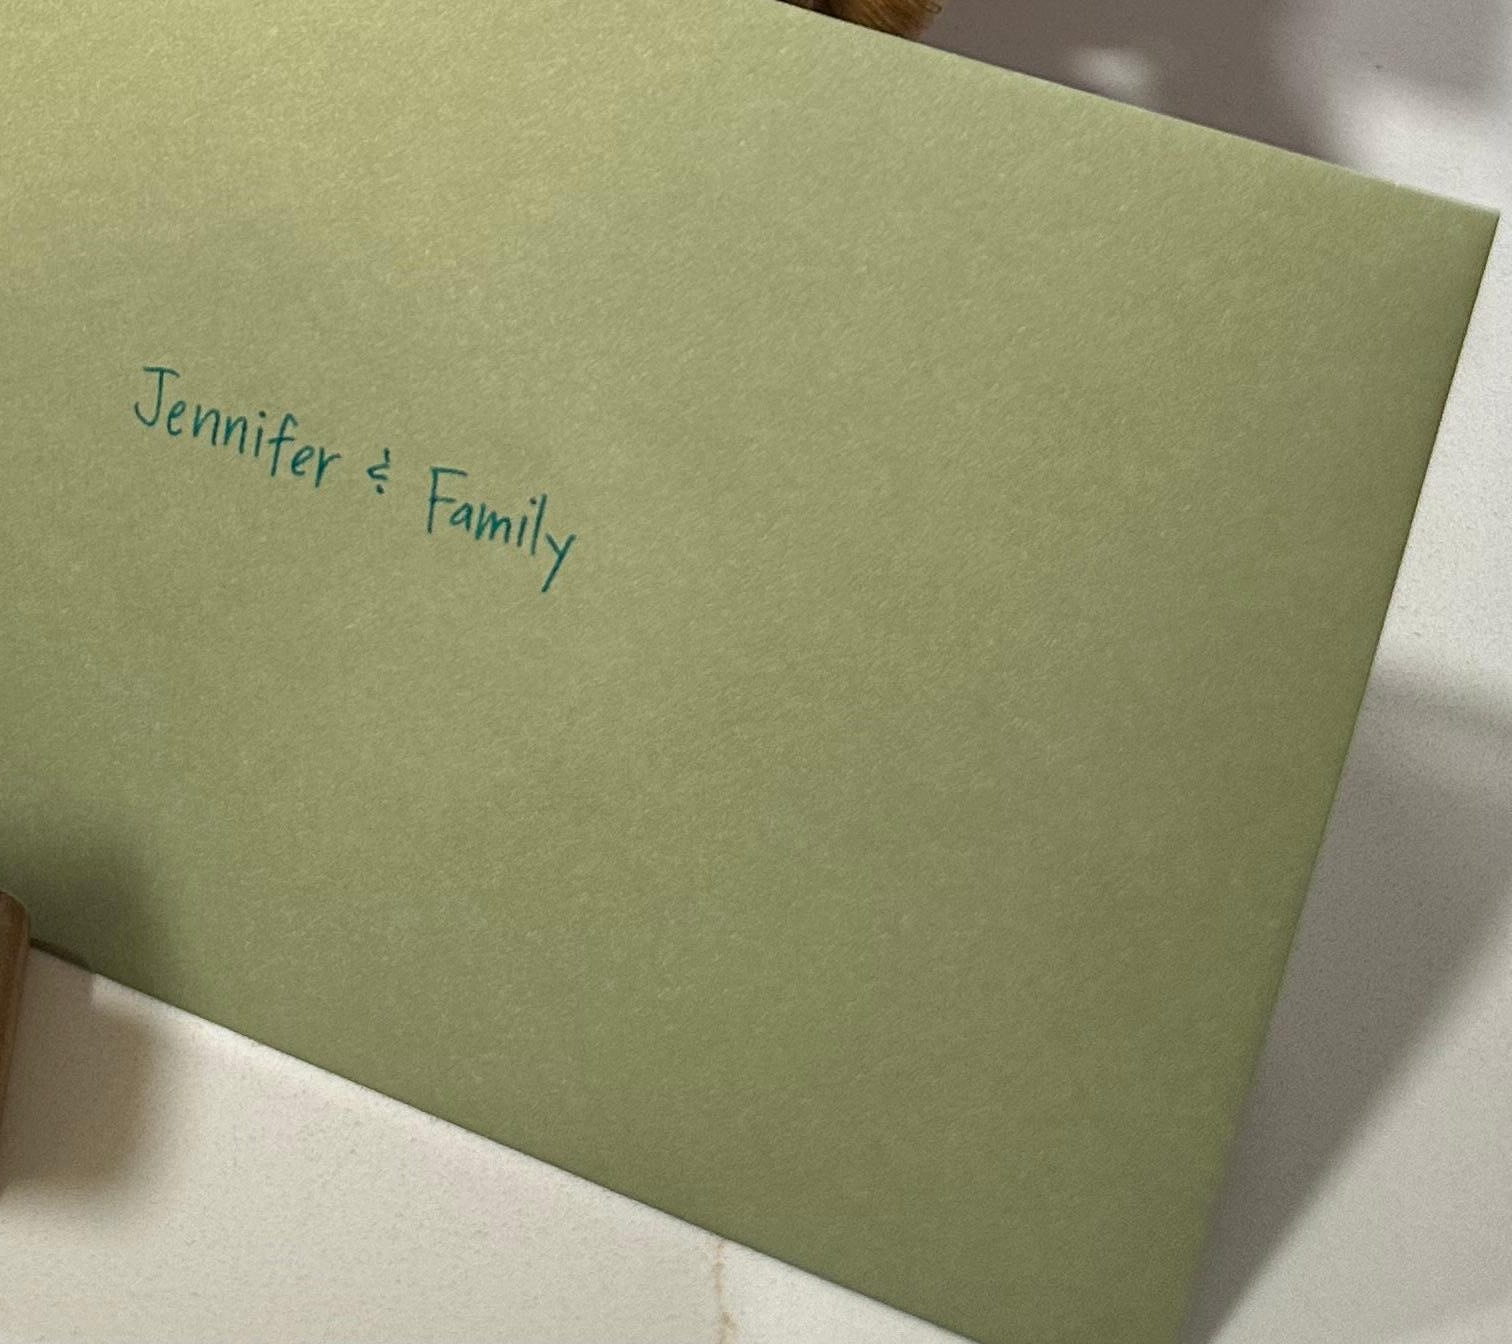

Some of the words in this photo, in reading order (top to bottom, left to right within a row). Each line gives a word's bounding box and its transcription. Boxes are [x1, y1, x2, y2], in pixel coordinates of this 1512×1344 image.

[133, 365, 342, 489] Jennifer
[366, 448, 390, 495] &
[426, 466, 577, 594] Family
